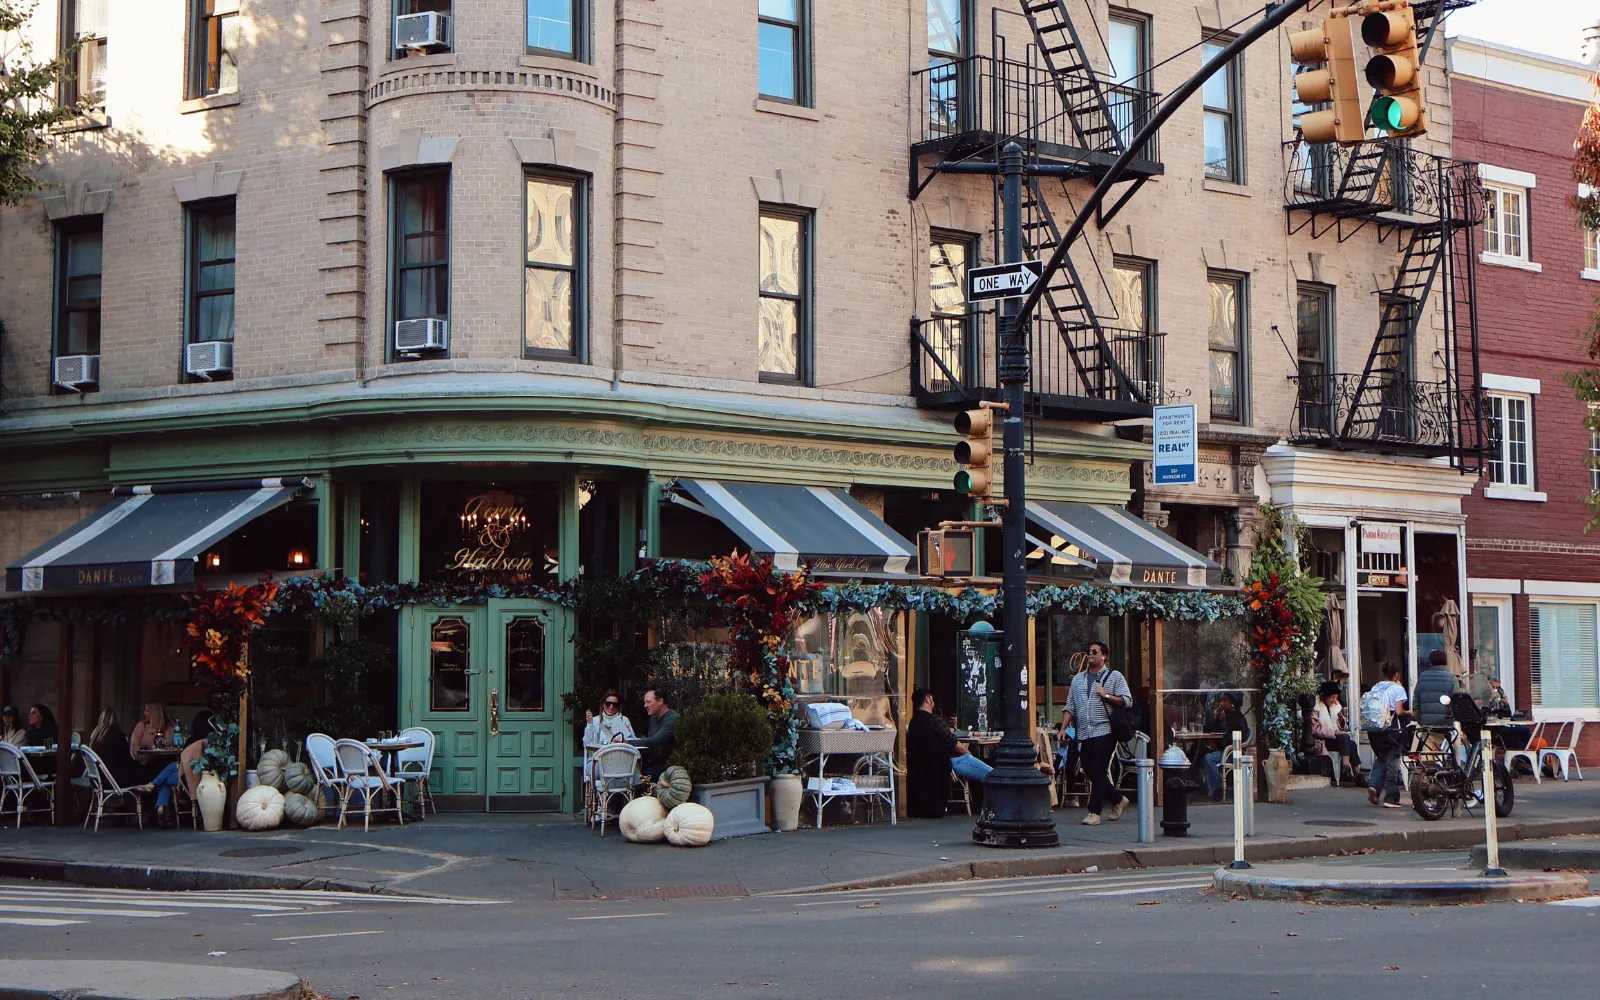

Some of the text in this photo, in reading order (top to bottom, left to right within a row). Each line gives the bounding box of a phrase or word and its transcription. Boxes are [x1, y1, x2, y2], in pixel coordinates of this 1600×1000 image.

[979, 272, 1031, 291] ONE WAY
[480, 524, 510, 549] &
[446, 547, 534, 571] Hudson
[815, 557, 872, 572] New York City
[78, 567, 115, 584] DANTE
[1143, 569, 1177, 583] DANTE
